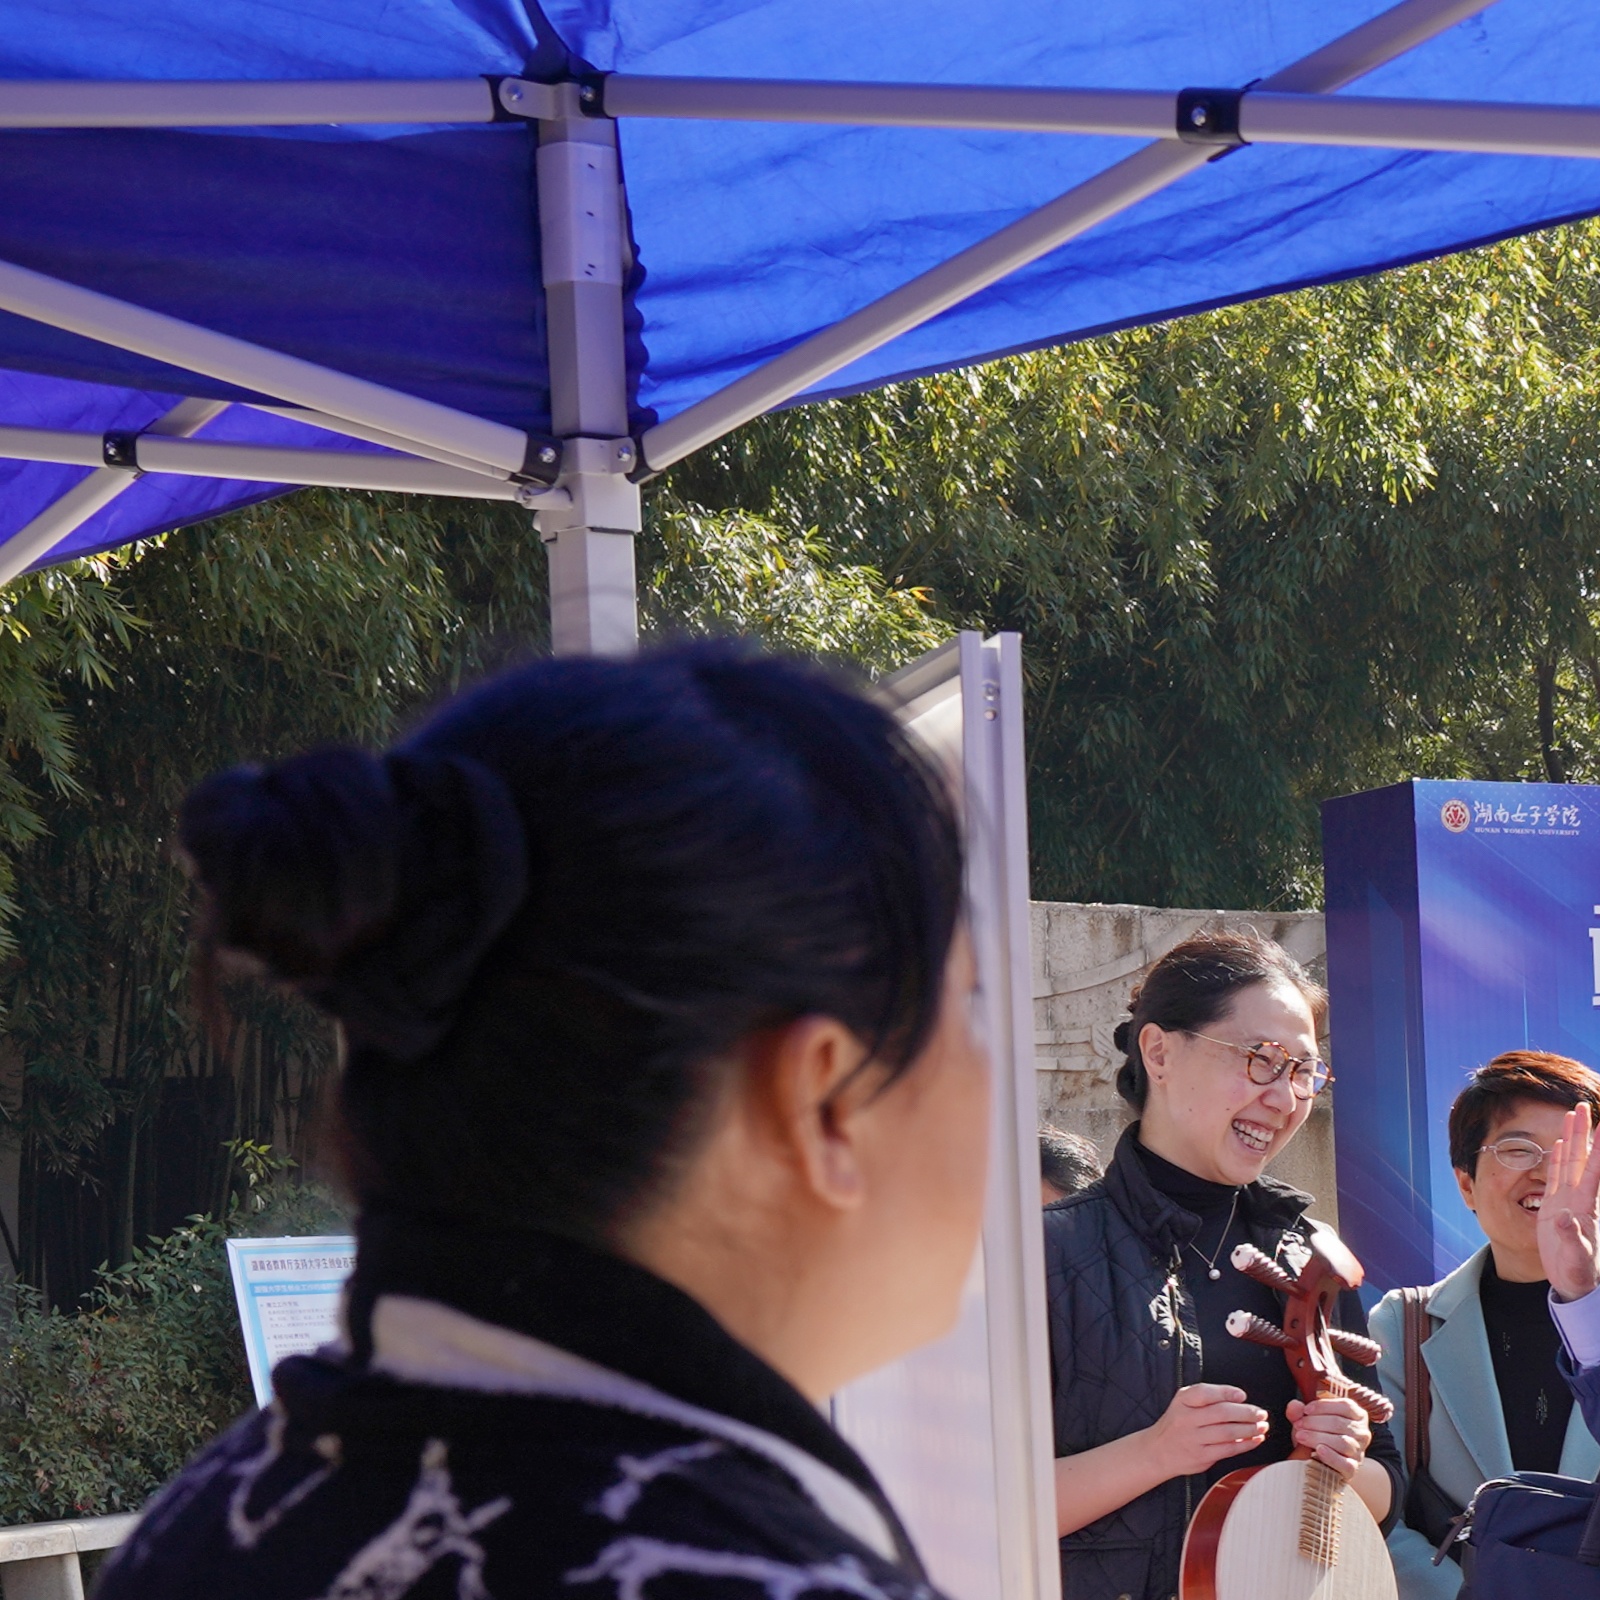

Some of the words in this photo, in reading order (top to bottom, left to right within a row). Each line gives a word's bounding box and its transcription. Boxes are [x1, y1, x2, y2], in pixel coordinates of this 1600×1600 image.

[1474, 801, 1581, 827] 湖南女子学院
